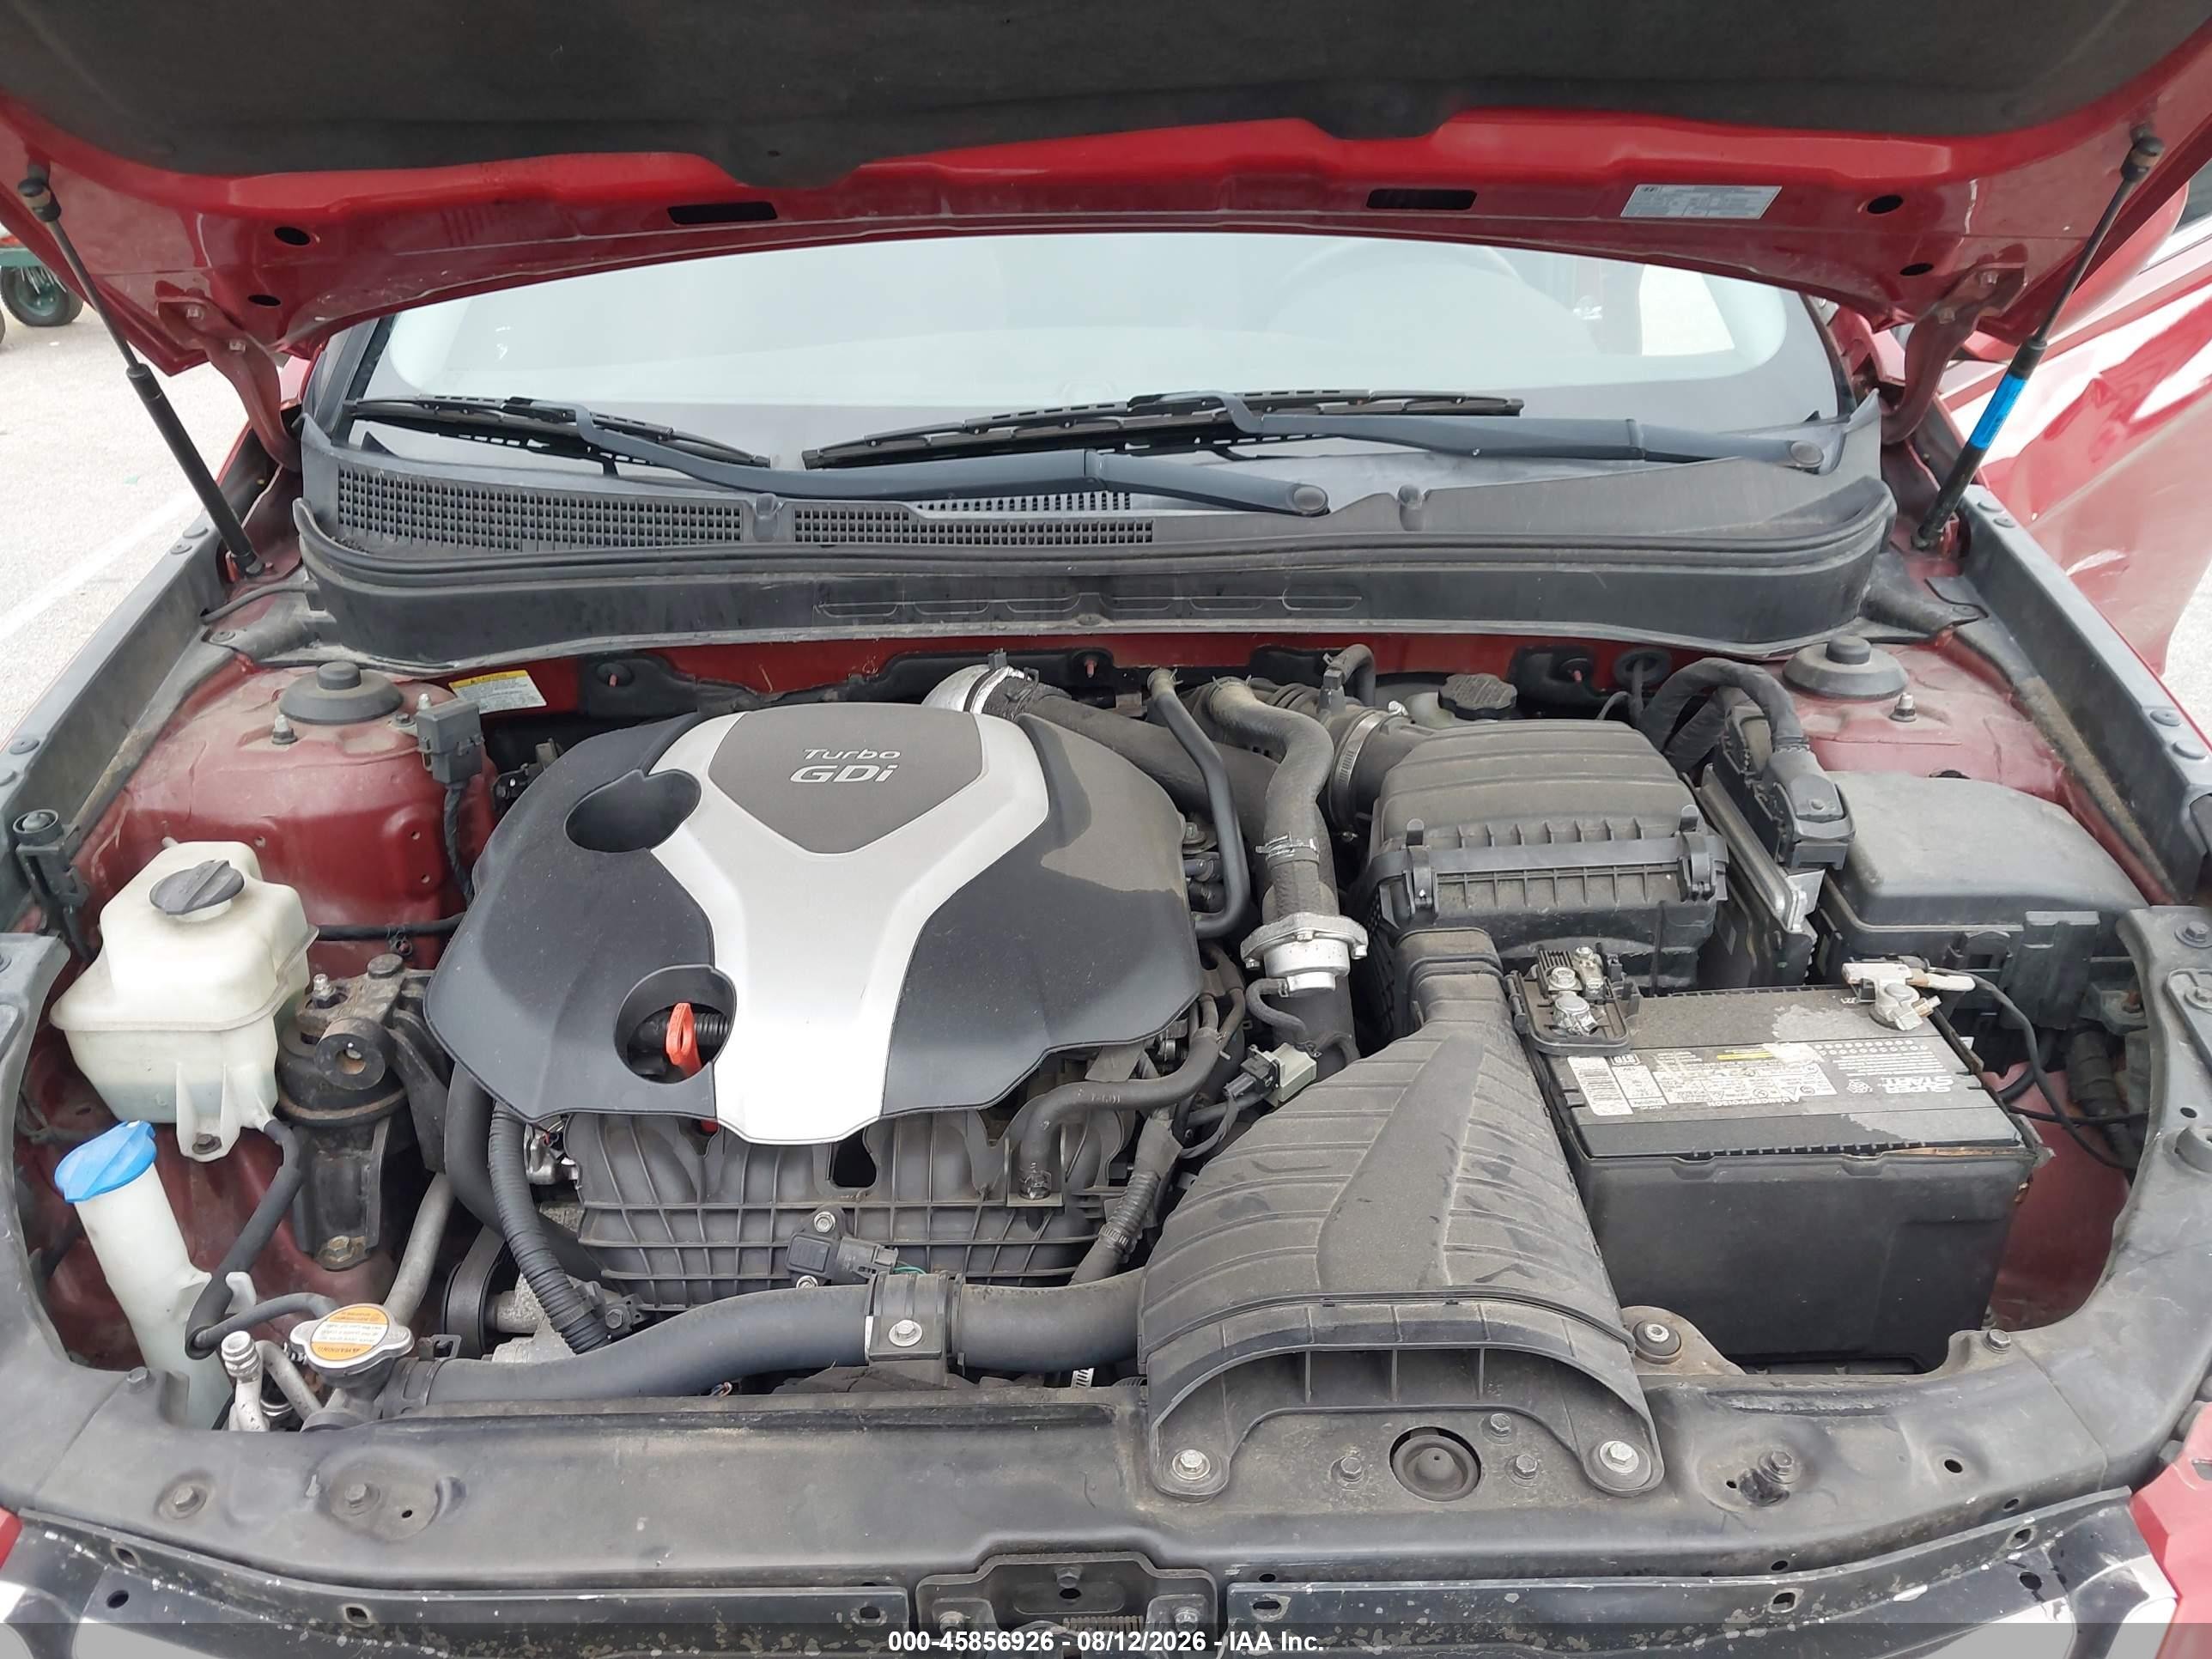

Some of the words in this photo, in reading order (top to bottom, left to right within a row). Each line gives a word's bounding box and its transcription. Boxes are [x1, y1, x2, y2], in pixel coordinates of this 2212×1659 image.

[803, 748, 902, 761] Turbo
[789, 763, 899, 783] GDi
[1885, 1085, 1952, 1094] SUPER
